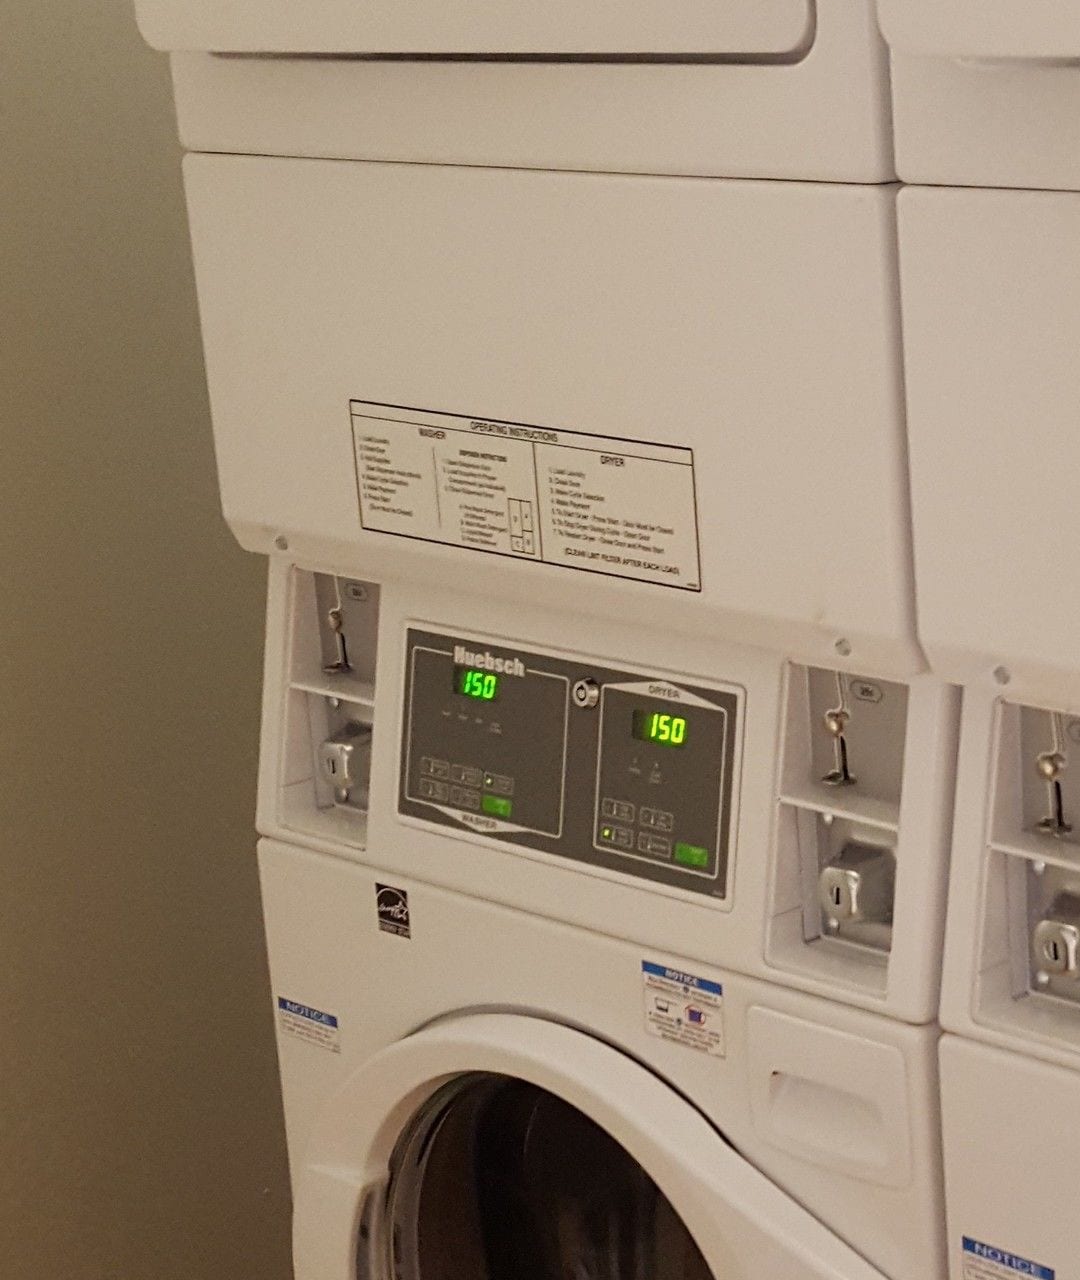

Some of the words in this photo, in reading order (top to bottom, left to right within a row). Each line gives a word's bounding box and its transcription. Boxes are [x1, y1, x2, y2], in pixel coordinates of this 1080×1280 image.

[470, 421, 507, 435] OPERATING
[509, 426, 558, 442] INSTRUCTIONS
[601, 455, 625, 467] DRYER
[454, 645, 526, 677] Huebsch
[463, 671, 497, 700] 150
[650, 713, 686, 744] 150
[974, 1243, 1042, 1278] NOTICE
